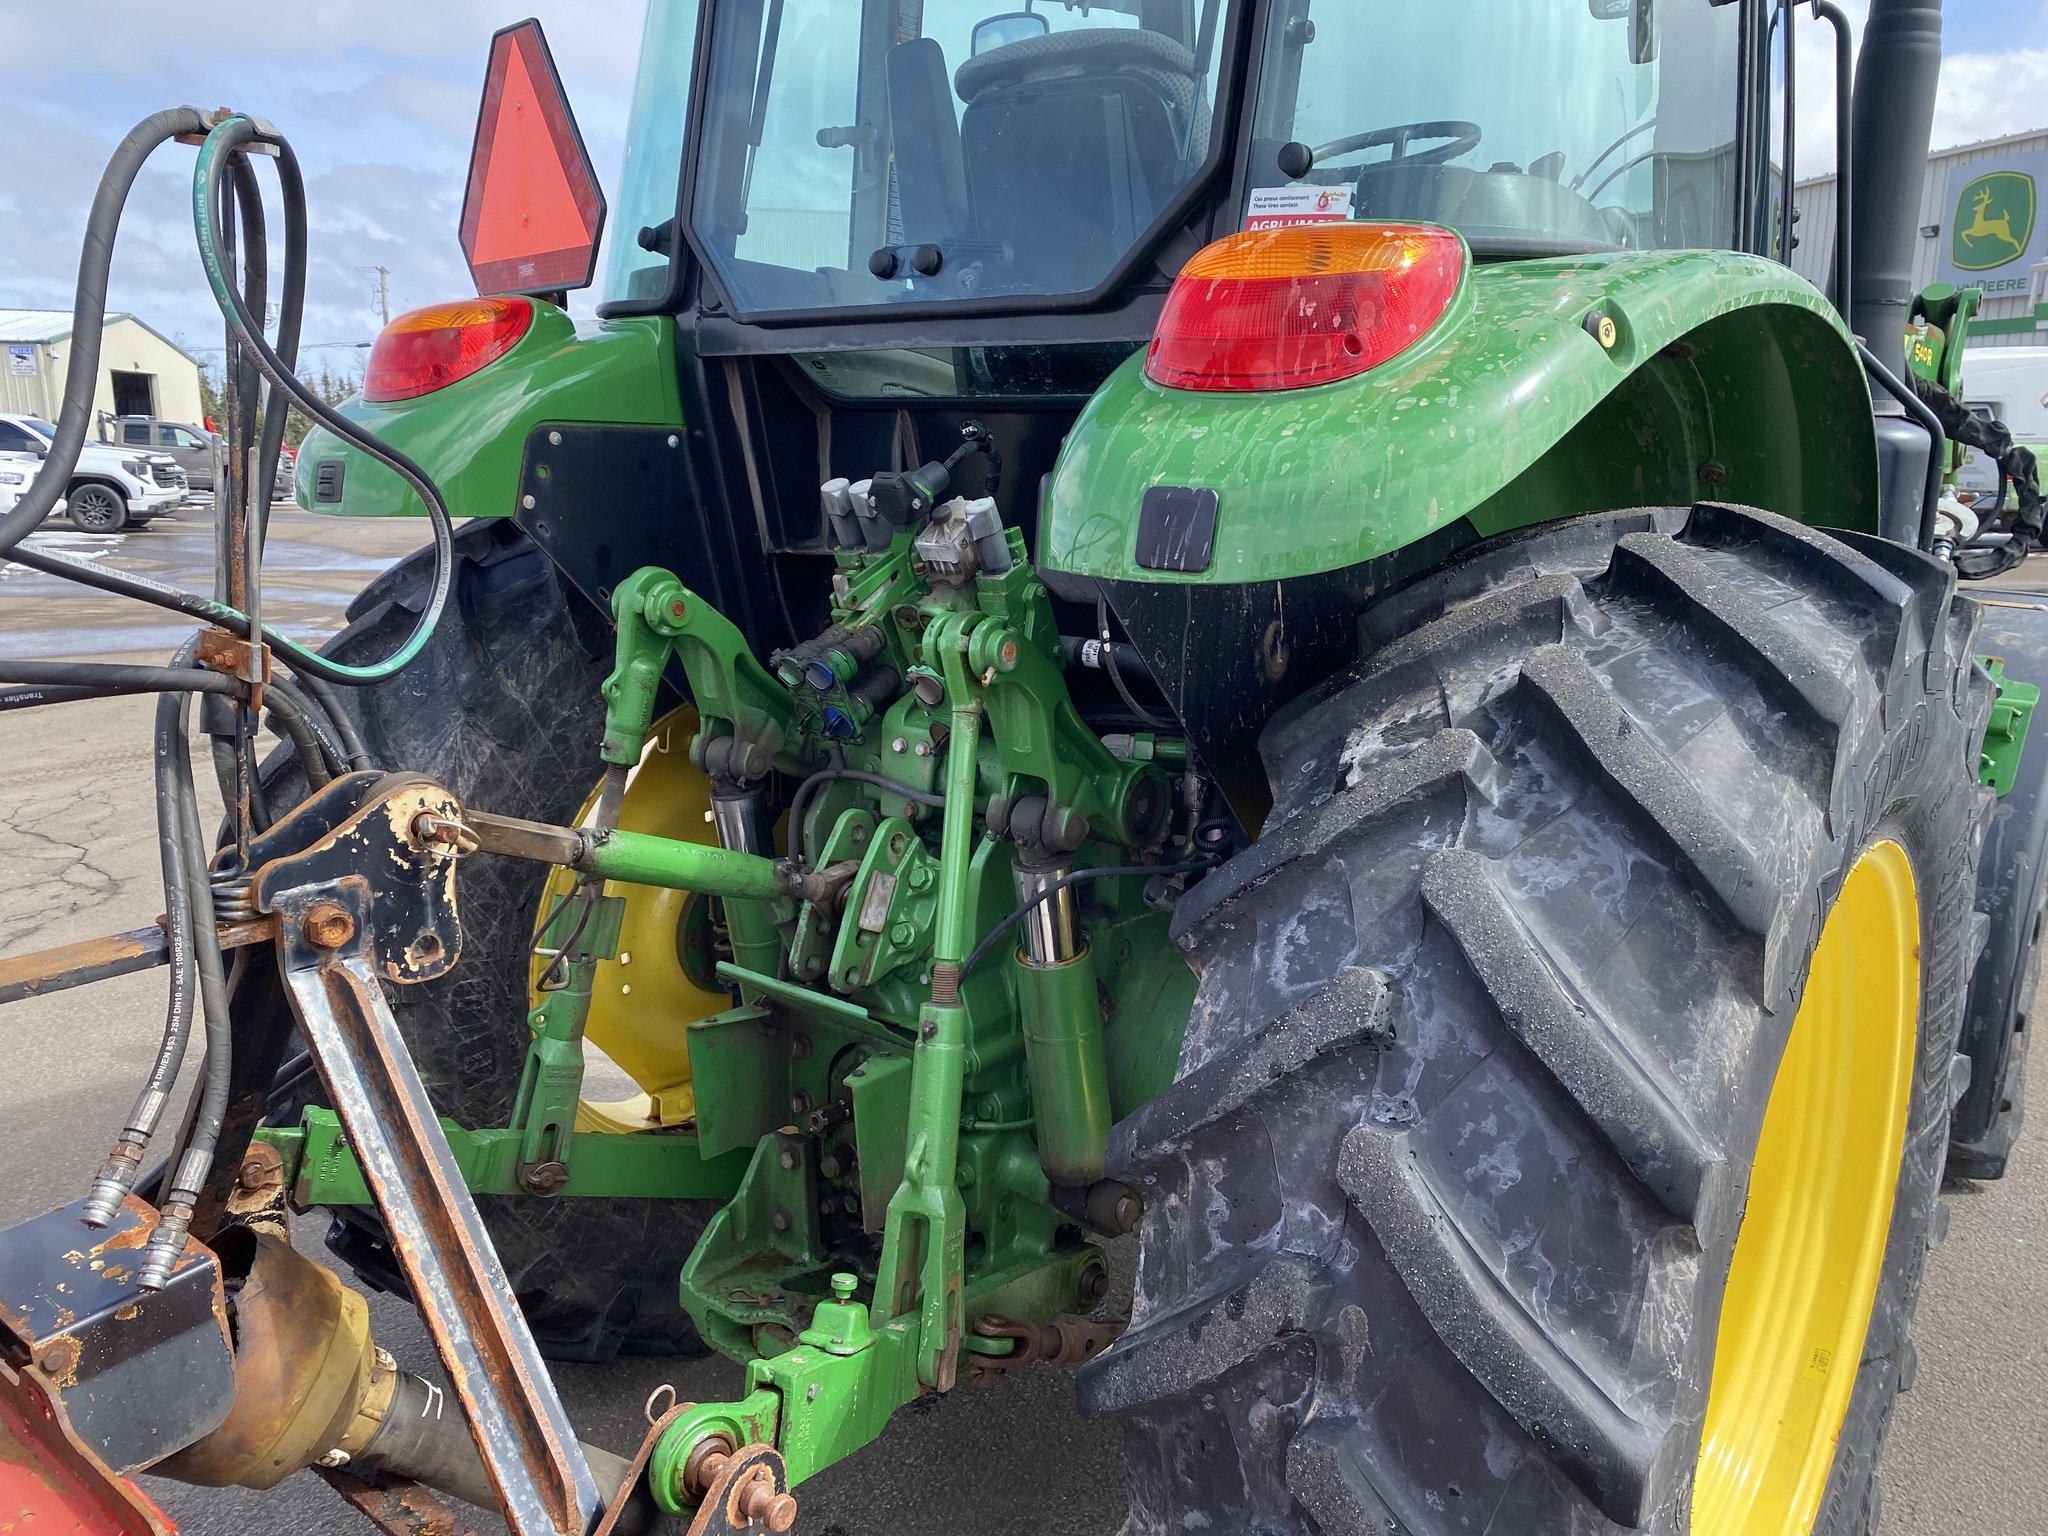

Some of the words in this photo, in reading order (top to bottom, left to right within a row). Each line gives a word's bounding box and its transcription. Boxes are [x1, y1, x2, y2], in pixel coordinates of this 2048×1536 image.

[1263, 195, 1278, 203] pneus
[1976, 278, 2027, 292] DEERE
[4, 691, 43, 702] Transflex
[176, 967, 184, 985] SAE
[173, 989, 182, 1014] DN10
[170, 1017, 179, 1032] 2SN
[166, 1036, 176, 1051] 853
[154, 1052, 172, 1080] DIN/EN
